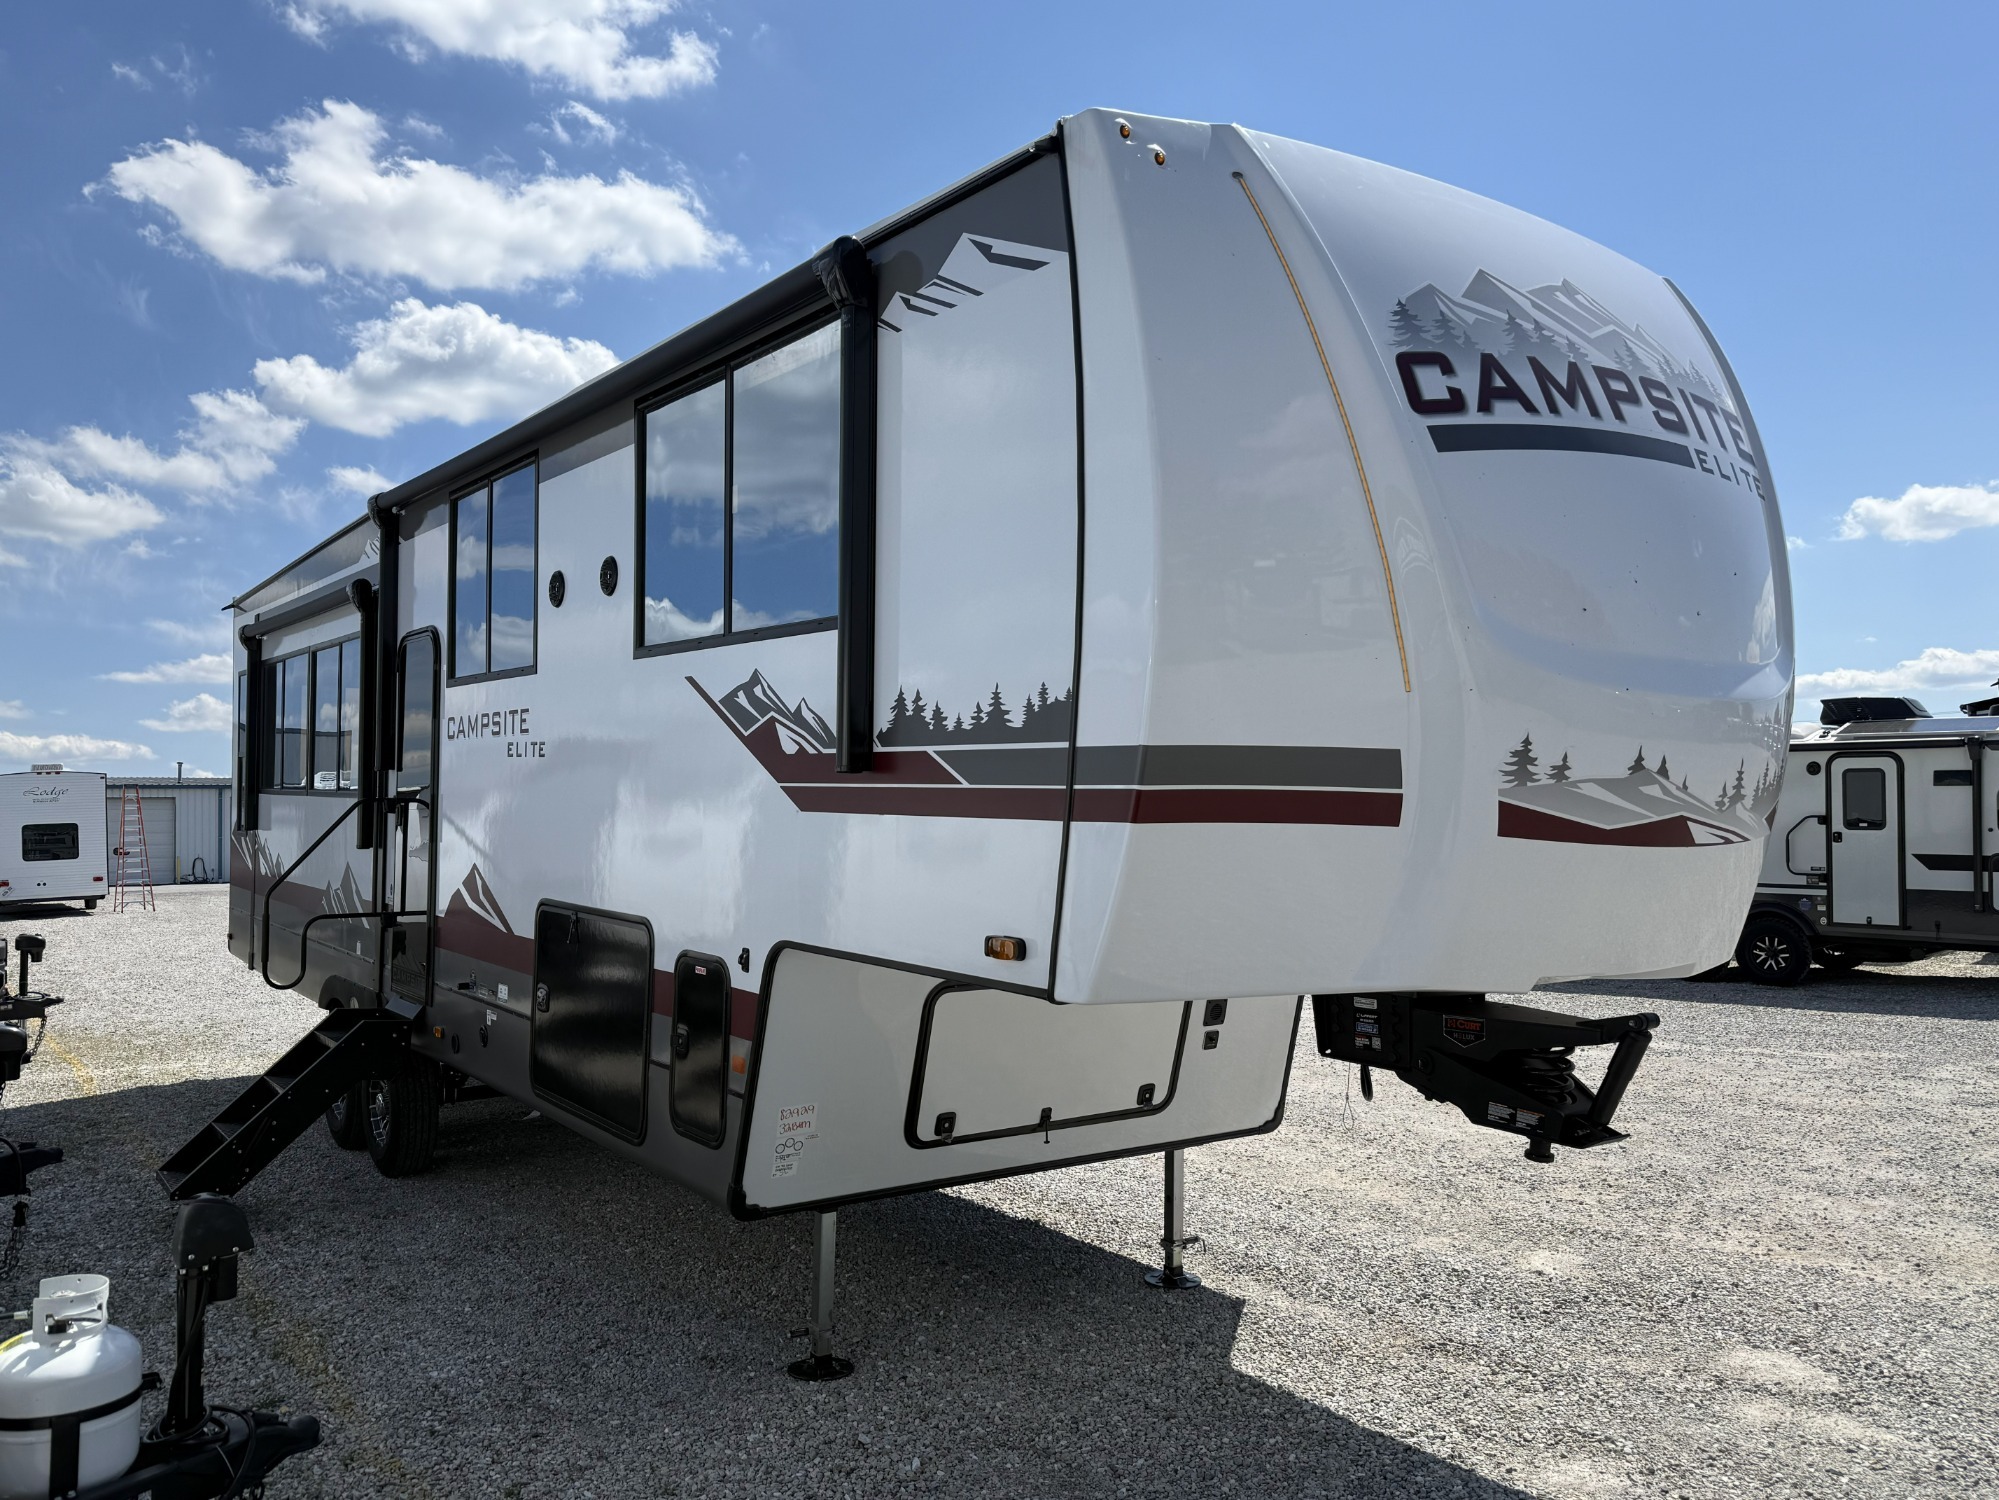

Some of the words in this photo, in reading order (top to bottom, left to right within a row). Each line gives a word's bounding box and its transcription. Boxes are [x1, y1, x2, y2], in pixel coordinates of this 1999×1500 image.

[1395, 351, 1756, 468] CAMPSITE
[1694, 448, 1766, 501] ELITE
[447, 708, 530, 740] CAMPSITE
[507, 741, 546, 757] ELITE
[23, 786, 69, 799] Lodge
[1457, 1019, 1481, 1031] CURT
